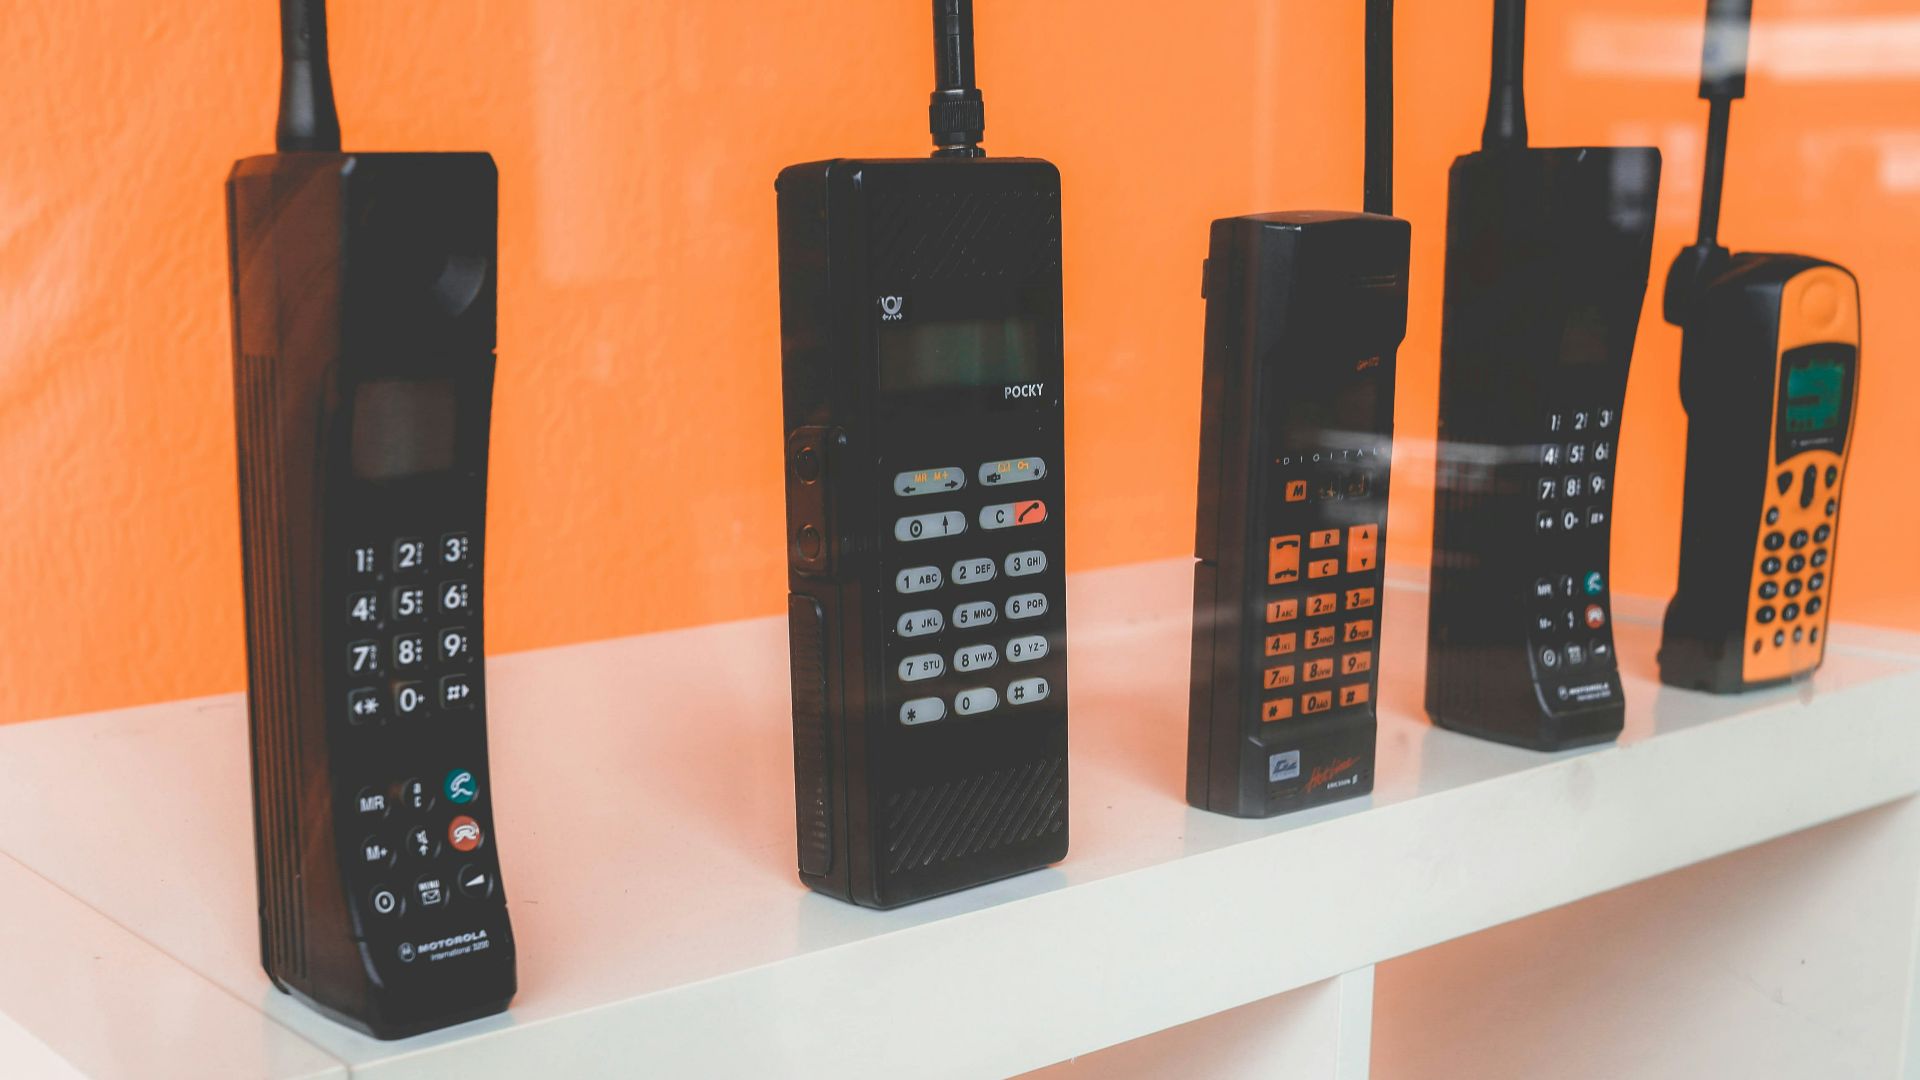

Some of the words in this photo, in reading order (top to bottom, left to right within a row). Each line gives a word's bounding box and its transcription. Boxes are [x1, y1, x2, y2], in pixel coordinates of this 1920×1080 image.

[1004, 384, 1044, 399] POCKY
[1551, 414, 1557, 431] 1
[1575, 412, 1584, 430] 2
[1600, 410, 1609, 428] 3
[1545, 448, 1554, 465] 4
[1570, 445, 1579, 463] 5
[1595, 443, 1604, 460] 6
[914, 473, 927, 483] MR
[1592, 476, 1601, 494] 9
[1293, 485, 1303, 496] M
[1542, 481, 1552, 499] 7
[1566, 478, 1576, 496] 8
[996, 510, 1005, 523] C
[1324, 533, 1331, 545] R
[400, 543, 415, 567] 2
[445, 538, 460, 561] 3
[355, 549, 364, 572] 1
[1013, 557, 1021, 571] 3
[1026, 556, 1041, 567] GHI
[959, 566, 967, 580] 2
[975, 563, 991, 575] DEF
[1322, 563, 1329, 574] C
[904, 576, 910, 588] 1
[919, 573, 938, 585] ABC
[399, 591, 414, 615] 5
[444, 585, 460, 609] 6
[1352, 592, 1360, 607] 3
[352, 597, 368, 621] 4
[1012, 600, 1020, 613] 6
[1027, 599, 1043, 610] PQR
[1275, 604, 1281, 619] 1
[1313, 598, 1321, 613] 2
[960, 609, 968, 623] 5
[973, 608, 992, 619] MNO
[905, 618, 913, 632] 4
[921, 616, 938, 629] JKL
[1311, 631, 1320, 646] 5
[1350, 625, 1357, 639] 6
[399, 640, 414, 664] 8
[444, 633, 460, 657] 9
[1013, 643, 1021, 656] 9
[1272, 638, 1280, 651] 4
[353, 646, 370, 671] 7
[961, 653, 969, 667] 8
[975, 652, 993, 663] VWX
[1348, 657, 1356, 671] 9
[906, 662, 914, 676] 7
[923, 659, 940, 671] STU
[1310, 663, 1318, 678] 8
[1270, 671, 1279, 685] 7
[1014, 686, 1024, 700] #
[962, 697, 970, 710] 0
[360, 795, 385, 812] MR
[418, 929, 487, 953] MOTOROLA
